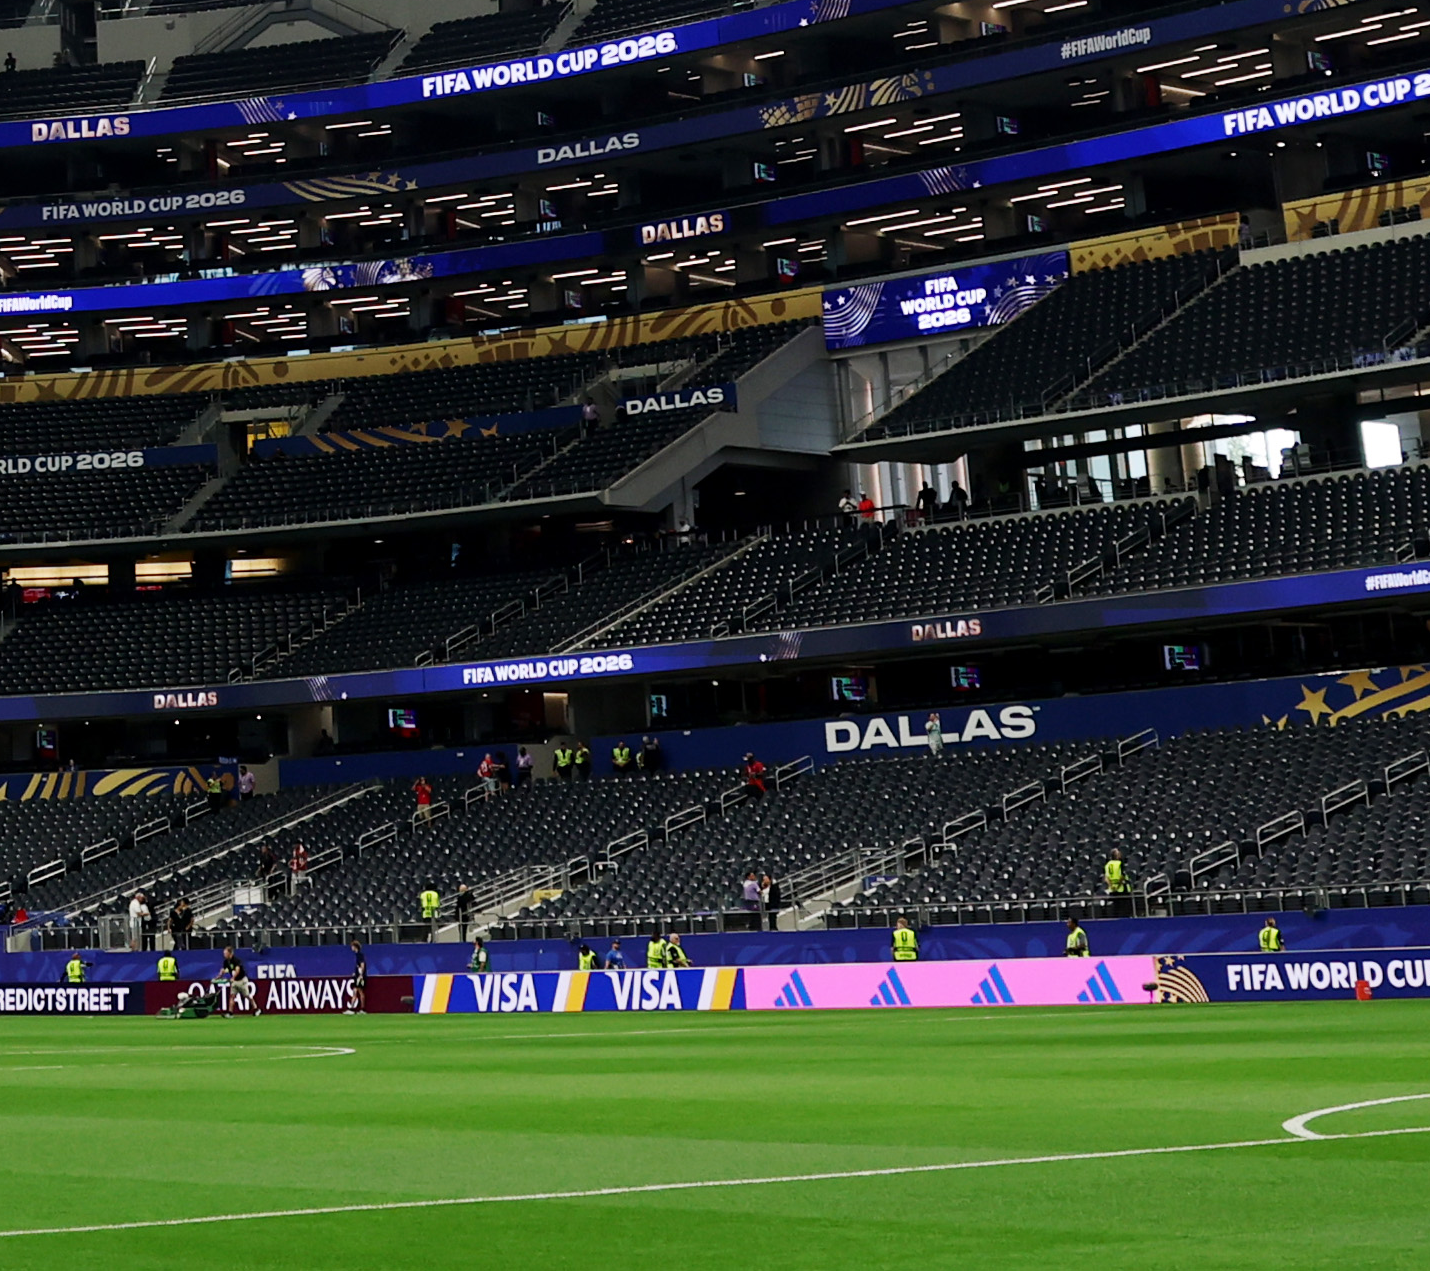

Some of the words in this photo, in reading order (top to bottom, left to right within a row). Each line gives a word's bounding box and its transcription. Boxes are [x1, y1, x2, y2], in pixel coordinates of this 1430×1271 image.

[1061, 28, 1150, 59] #FIFAWorldCup
[423, 72, 471, 97] FIFA
[472, 59, 553, 88] WORLD
[557, 49, 598, 74] CUP
[601, 32, 677, 65] 2026
[1224, 108, 1274, 135] FIFA
[1274, 90, 1360, 124] WORLD
[1363, 79, 1410, 106] CUP
[32, 117, 129, 141] DALLAS
[538, 133, 639, 163] DALLAS
[43, 205, 79, 220] FIFA
[82, 200, 145, 217] WORLD
[149, 197, 182, 212] CUP
[186, 190, 245, 208] 2026
[642, 215, 723, 243] DALLAS
[925, 277, 958, 295] FIFA
[901, 294, 955, 315] WORLD
[956, 288, 986, 306] CUP
[918, 308, 971, 329] 2026
[626, 385, 723, 414] DALLAS
[35, 456, 73, 472] CUP
[77, 452, 143, 469] 2026
[912, 619, 980, 640] DALLAS
[463, 667, 494, 684] FIFA
[499, 662, 547, 681] WORLD
[549, 659, 578, 676] CUP
[580, 654, 633, 673] 2026
[154, 692, 217, 708] DALLAS
[825, 705, 1036, 752] DALLAS
[1227, 964, 1284, 990] FIFA
[1284, 960, 1383, 989] WORLD
[469, 973, 538, 1012] VISA
[605, 971, 683, 1011] VISA
